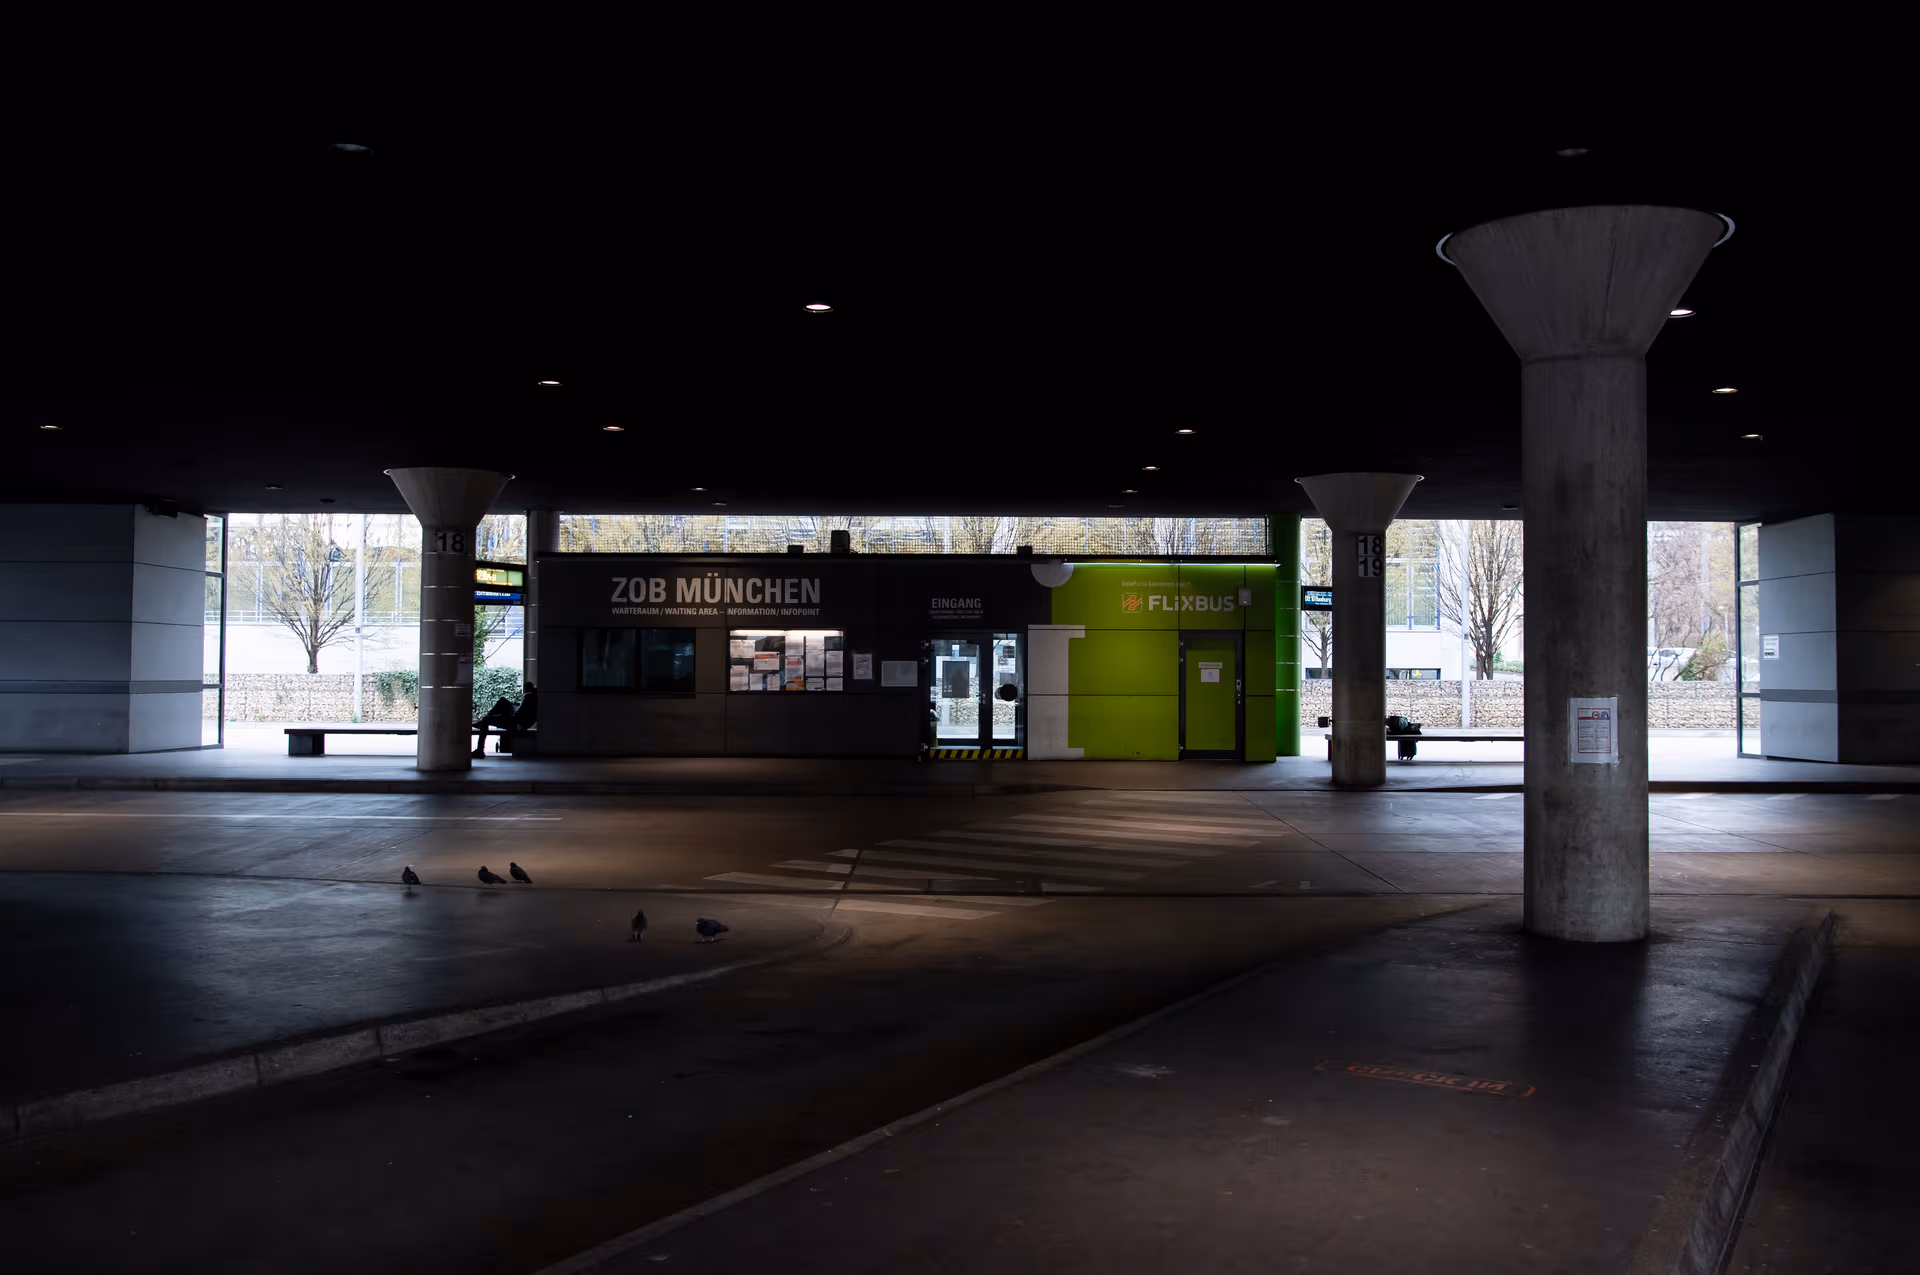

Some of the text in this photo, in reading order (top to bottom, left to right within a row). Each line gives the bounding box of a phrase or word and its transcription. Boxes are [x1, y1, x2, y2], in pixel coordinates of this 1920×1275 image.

[438, 533, 465, 553] 18
[1359, 536, 1383, 555] 18
[1359, 558, 1383, 577] 19
[611, 572, 821, 604] ZOB MÜNCHEN
[611, 607, 660, 615] WARTERAUM
[665, 607, 697, 615] WAITING
[698, 607, 719, 616] AREA
[780, 607, 820, 616] INFOPOINT
[931, 597, 982, 609] EINGANG
